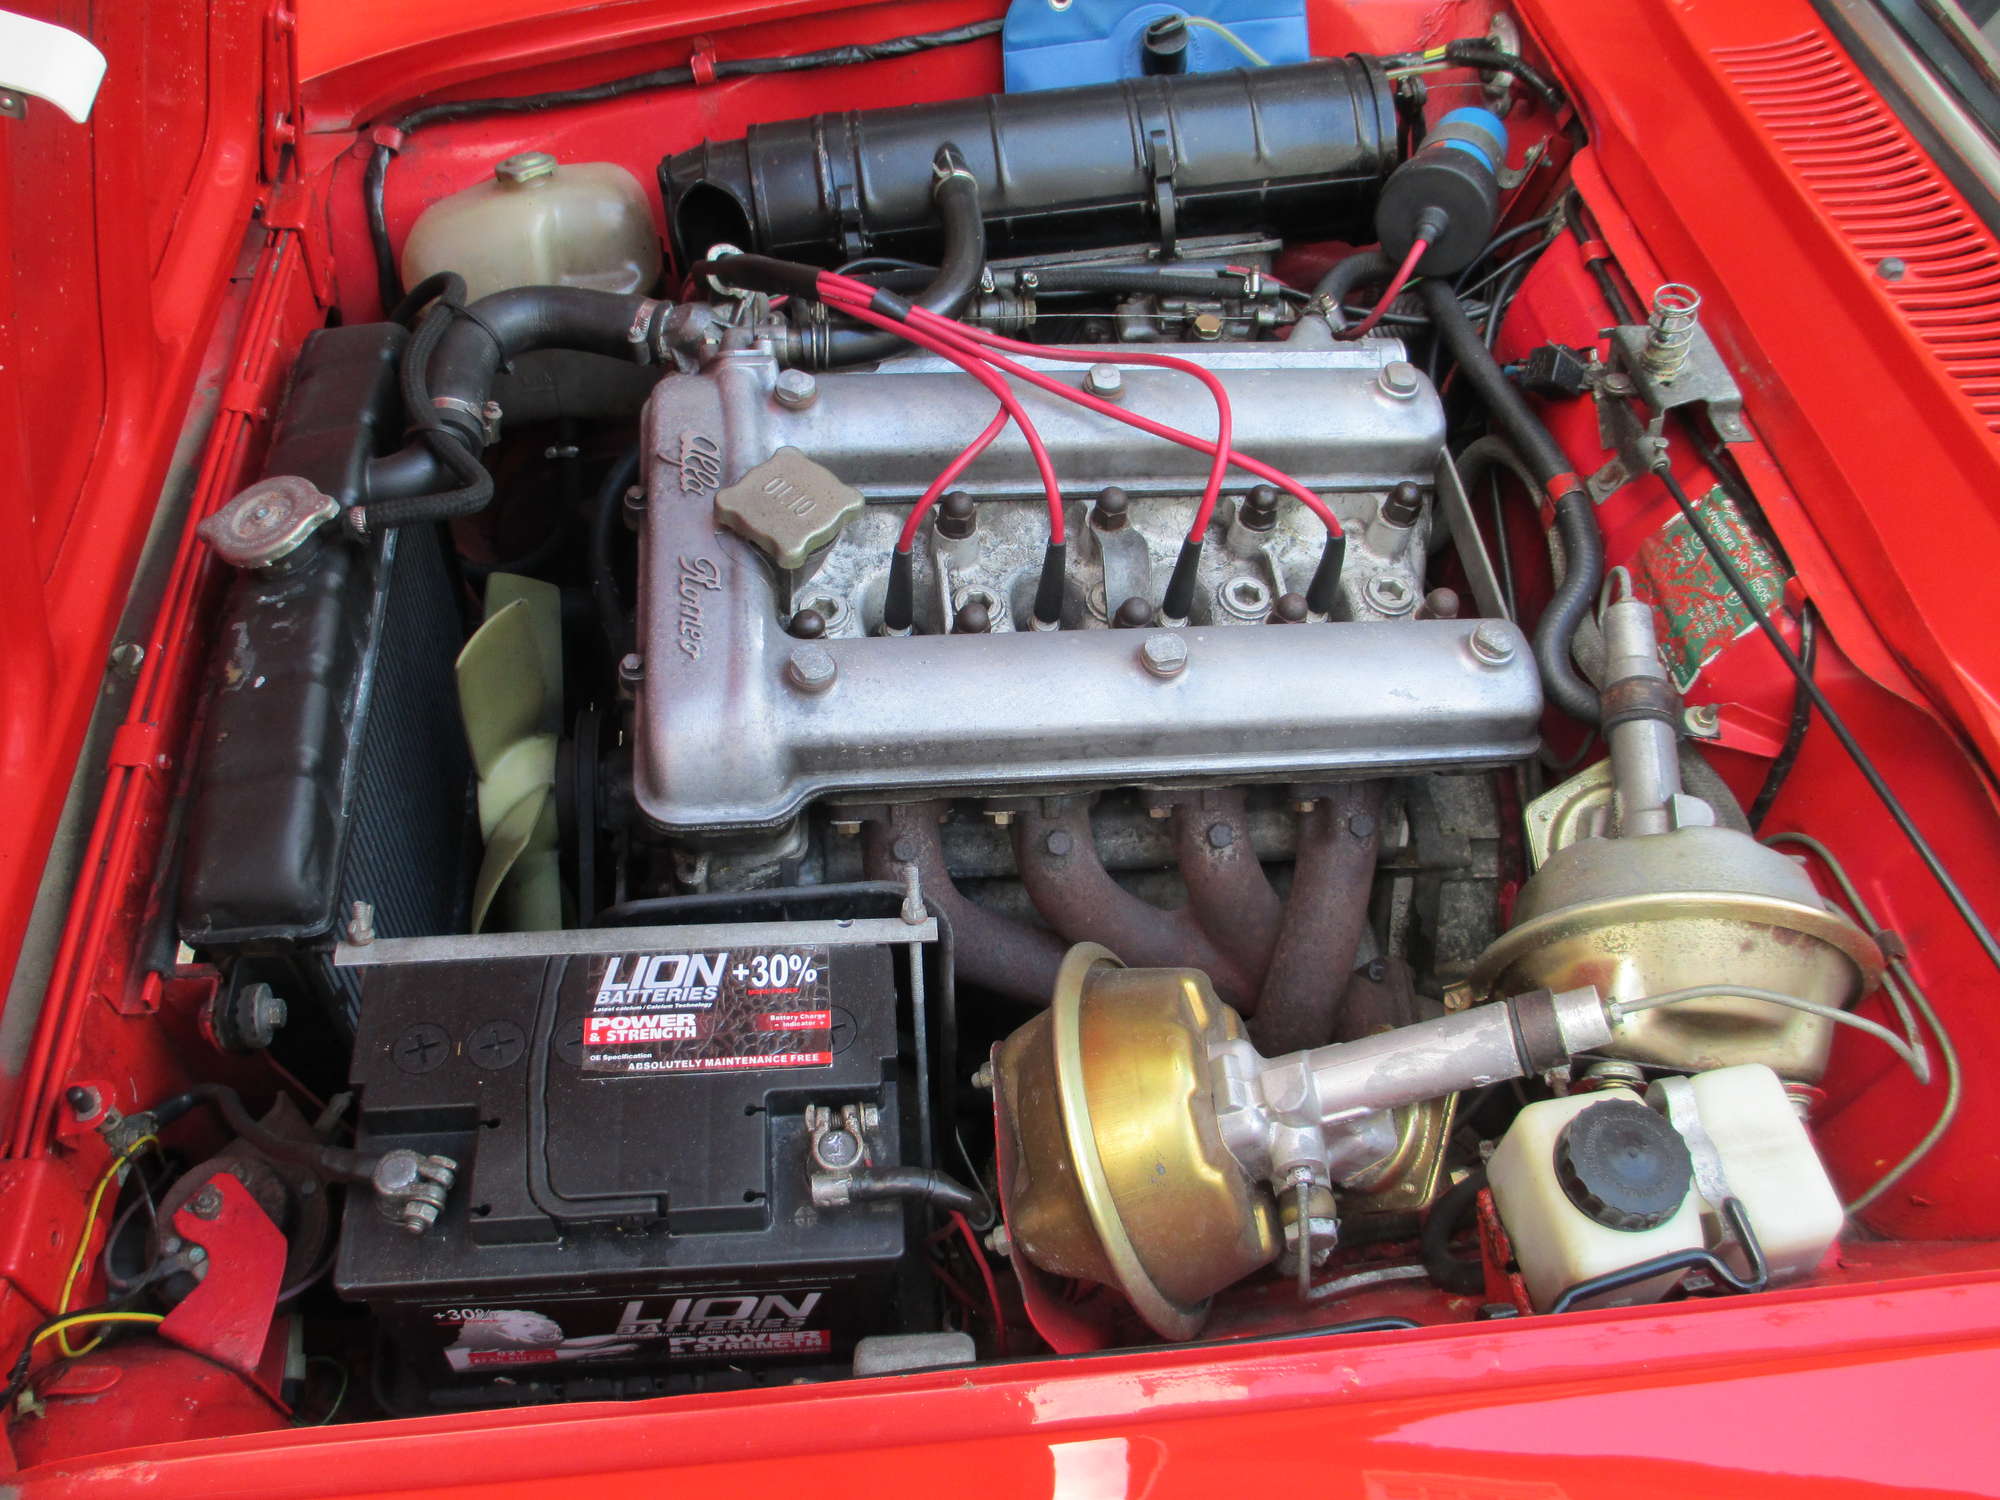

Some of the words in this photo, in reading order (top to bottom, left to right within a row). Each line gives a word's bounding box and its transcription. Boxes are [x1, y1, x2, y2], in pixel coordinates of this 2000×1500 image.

[657, 430, 721, 496] Alfa
[679, 554, 722, 661] Romeo
[599, 952, 729, 991] LION
[732, 953, 818, 989] +30%
[594, 986, 719, 1005] BATTERIES
[674, 1001, 713, 1010] Technology
[590, 1013, 697, 1031] POWER
[770, 1014, 798, 1022] Battery
[799, 1013, 826, 1021] Charge
[588, 1032, 601, 1043] &
[606, 1026, 697, 1043] STRENGTH
[602, 1052, 652, 1062] Specification
[627, 1059, 702, 1071] ABSOLUTELY
[704, 1055, 788, 1067] MAINTENANCE
[790, 1053, 819, 1062] FREE
[619, 1292, 823, 1325] LION
[615, 1316, 807, 1336] BATTERIES
[668, 1330, 821, 1346] POWER
[693, 1338, 823, 1352] STRENGTH
